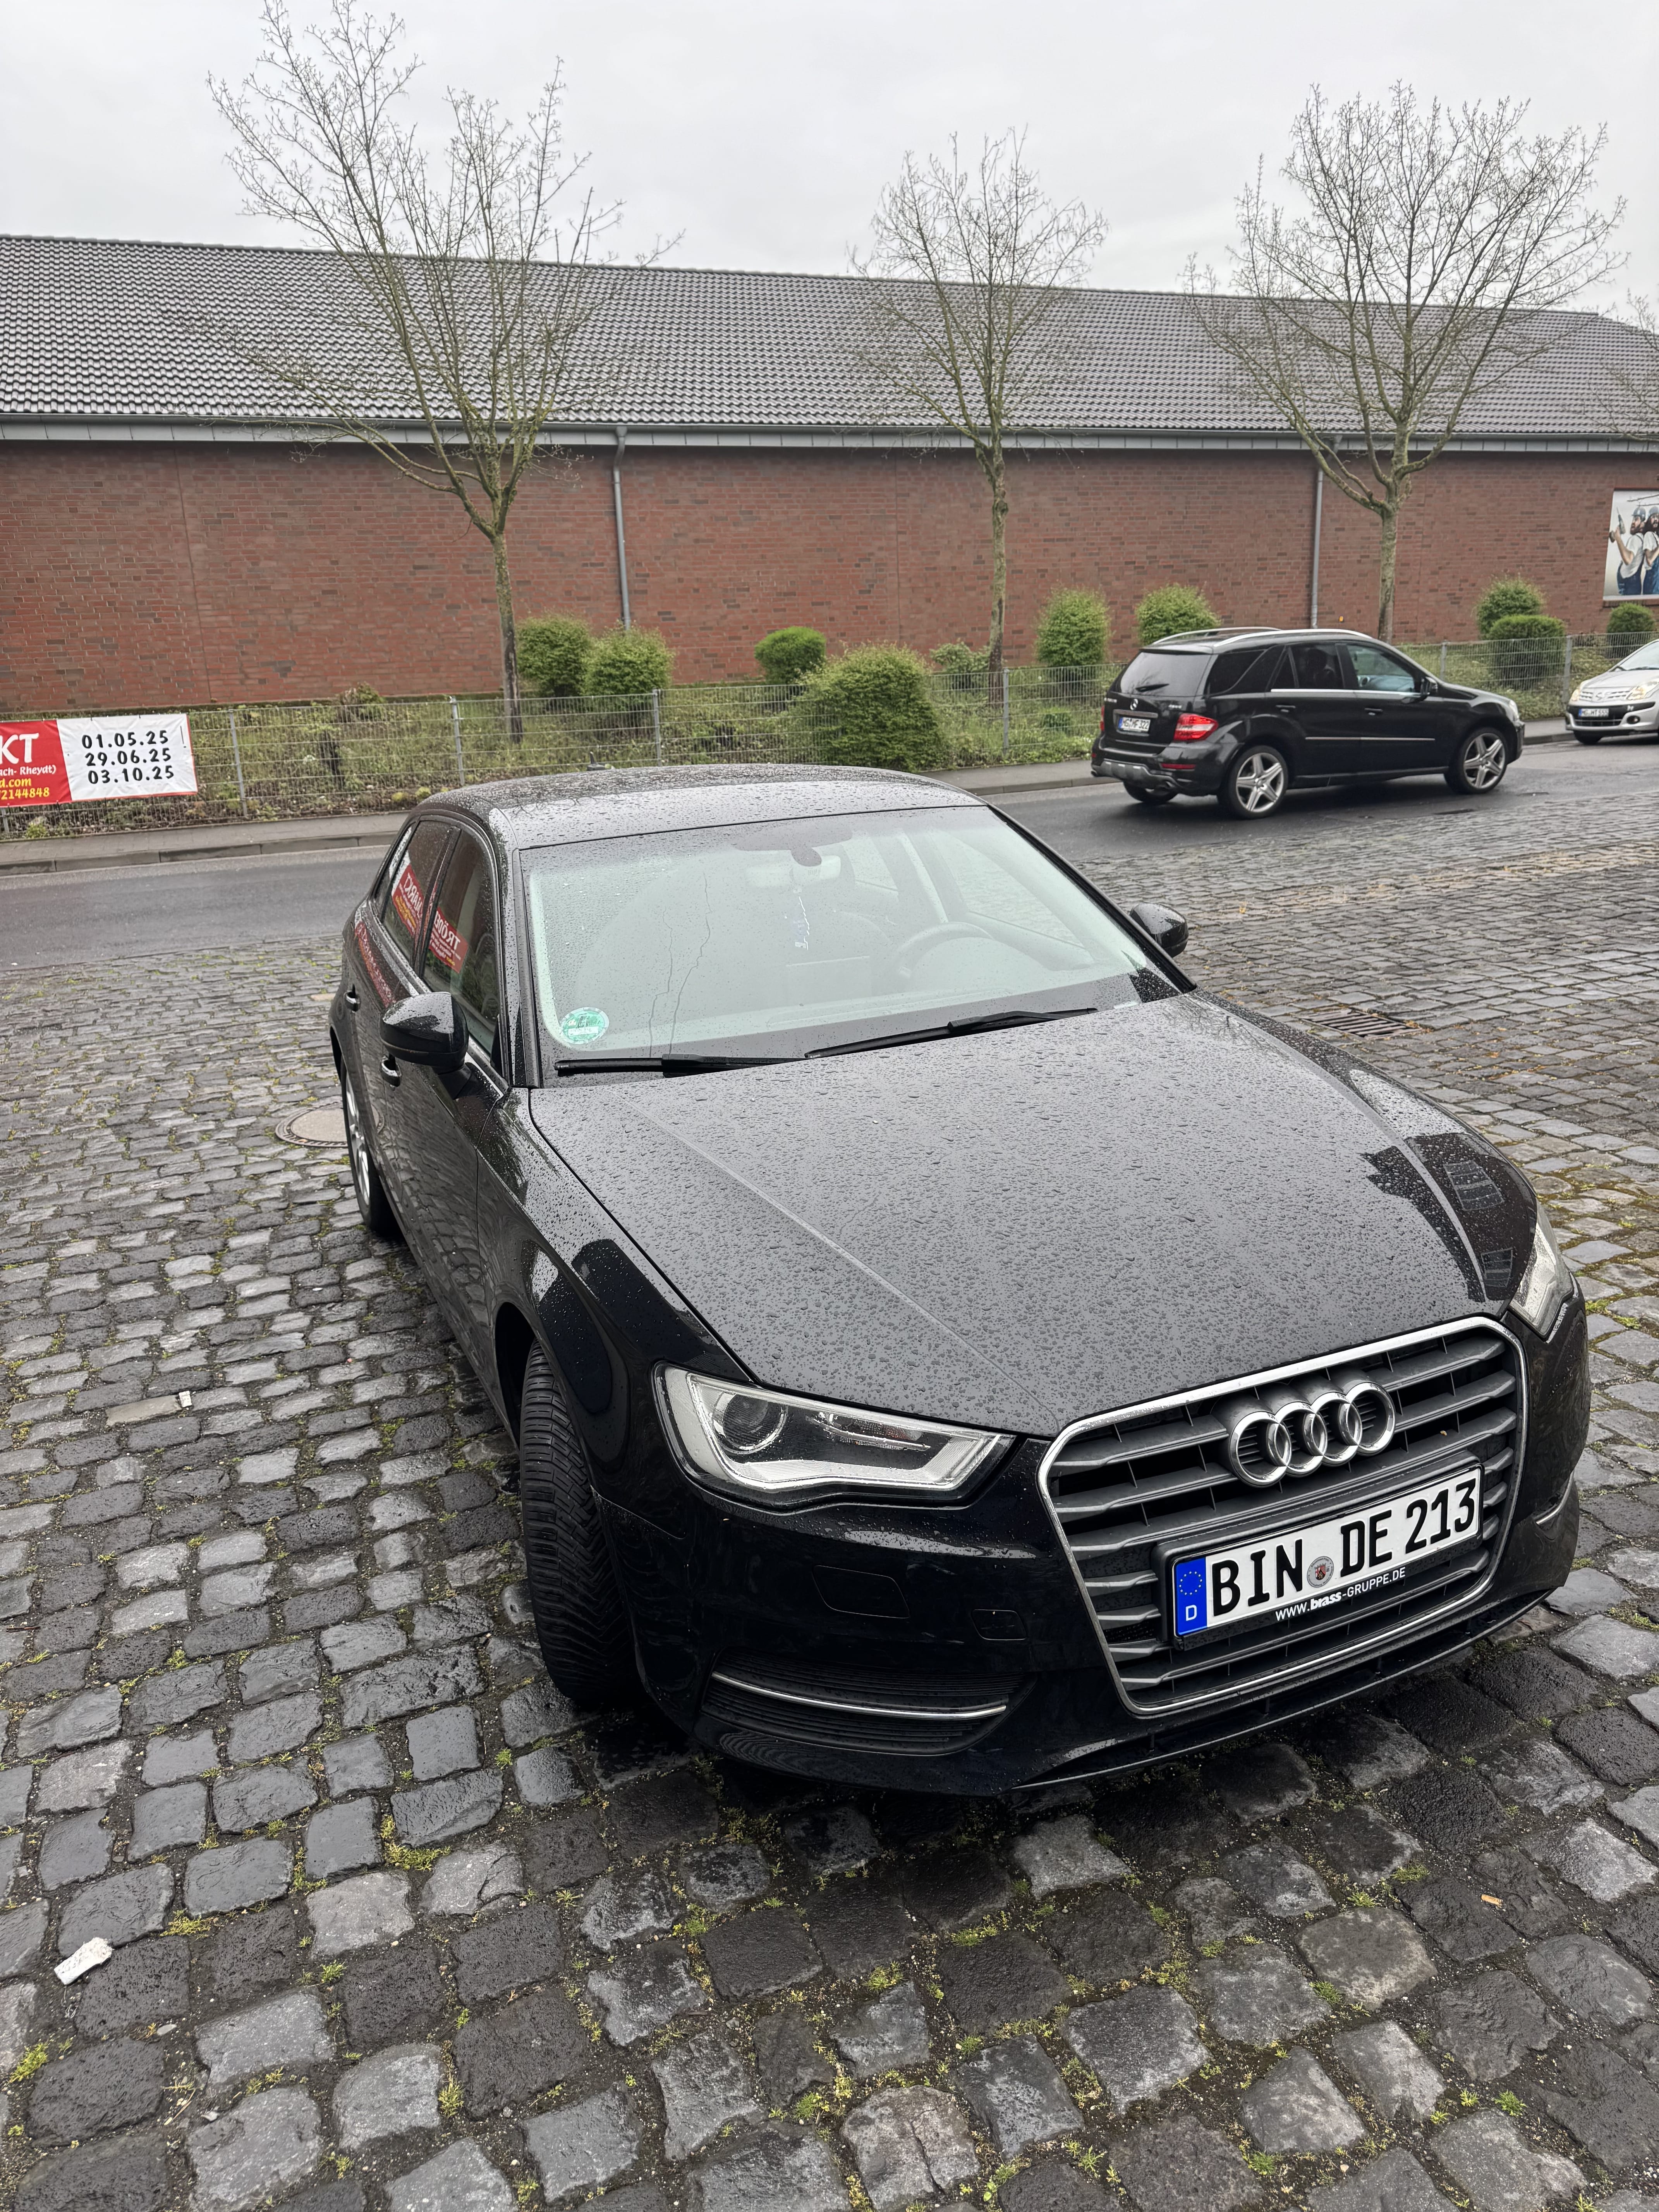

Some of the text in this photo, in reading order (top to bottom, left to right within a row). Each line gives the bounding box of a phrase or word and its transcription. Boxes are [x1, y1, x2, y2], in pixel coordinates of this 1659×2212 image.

[82, 730, 168, 749] 01.05.25
[85, 748, 171, 766] 29.06.25
[20, 764, 56, 775] Rheydt)
[88, 765, 174, 784] 03.10.25
[0, 787, 50, 800] 2144848
[1212, 1478, 1476, 1617] BIN DE 213
[1186, 1604, 1197, 1621] D
